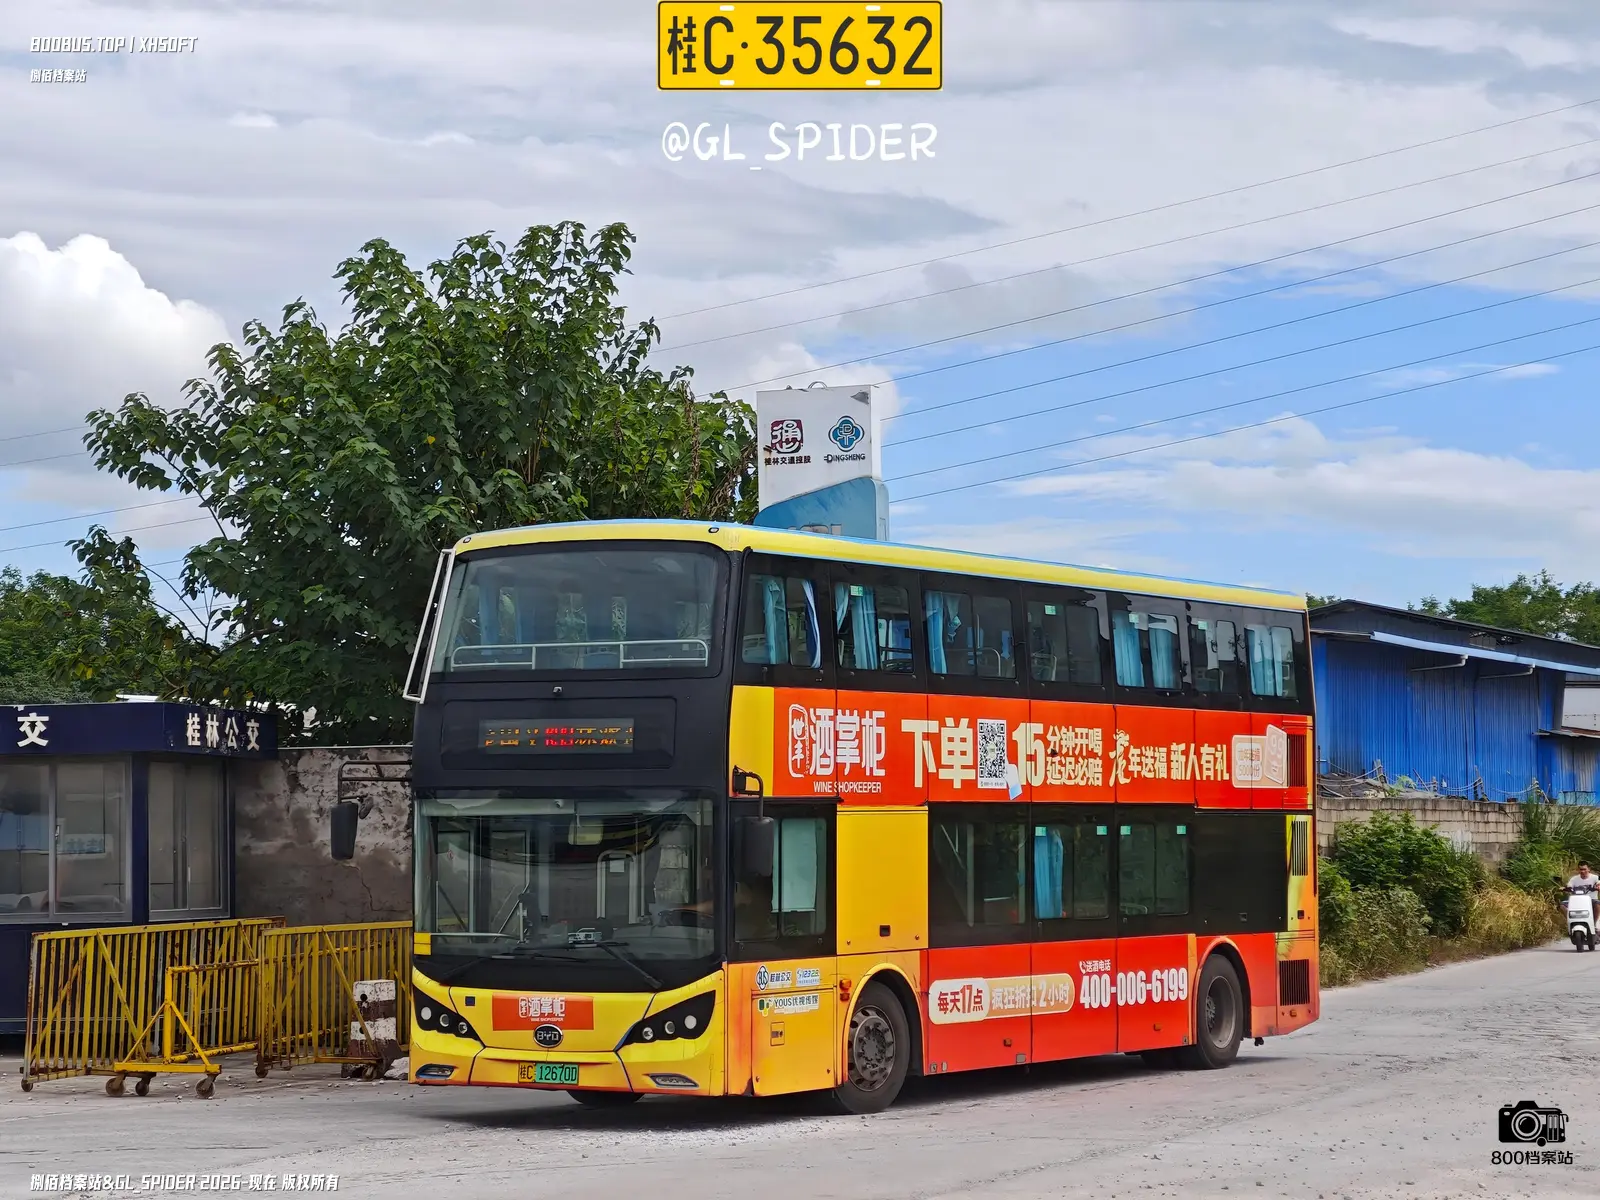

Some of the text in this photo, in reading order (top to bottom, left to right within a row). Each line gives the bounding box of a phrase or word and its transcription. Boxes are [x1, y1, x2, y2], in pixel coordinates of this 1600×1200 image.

[17, 712, 49, 747] 交
[186, 712, 260, 751] 桂林公交
[809, 708, 886, 777] 酒掌柜
[1046, 725, 1103, 756] 分钟开喝
[901, 717, 976, 789] 下单
[1170, 742, 1230, 781] 新人有礼
[813, 781, 882, 793] WINE SHOPKEEPER
[1046, 757, 1103, 787] 延迟必赔
[937, 984, 984, 1015] 每天17点
[1080, 967, 1188, 1009] 400-006-6199
[529, 997, 565, 1016] 酒掌柜
[536, 1031, 559, 1041] BYD
